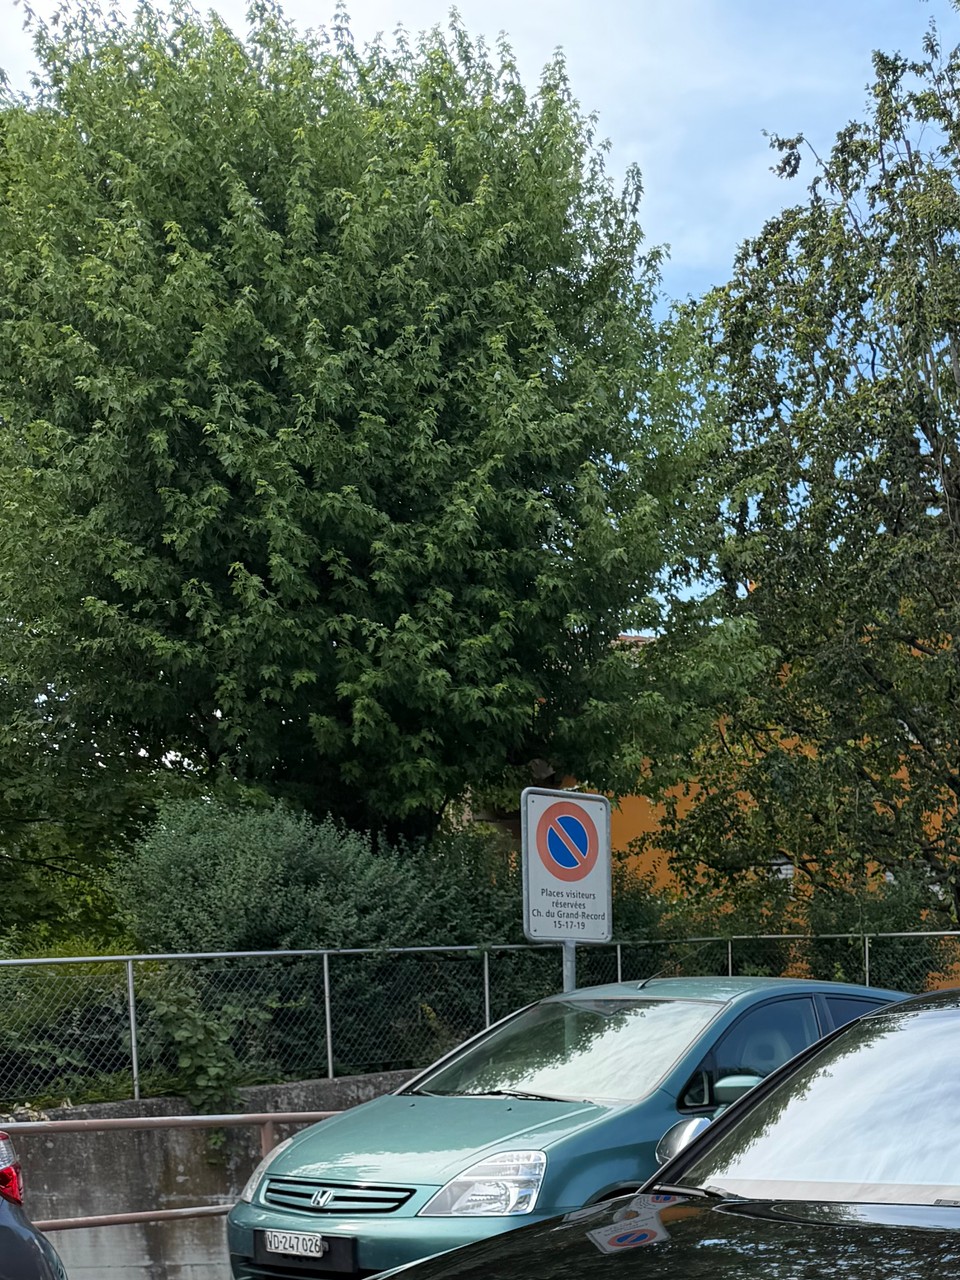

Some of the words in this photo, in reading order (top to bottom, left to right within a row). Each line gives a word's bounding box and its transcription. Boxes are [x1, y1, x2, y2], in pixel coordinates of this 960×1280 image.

[541, 888, 564, 898] Places
[566, 890, 596, 900] visiteurs
[552, 900, 586, 909] réservées
[531, 908, 544, 918] Ch.
[545, 909, 555, 918] du
[556, 910, 606, 921] Grand-Record
[553, 920, 586, 930] 15-17-19
